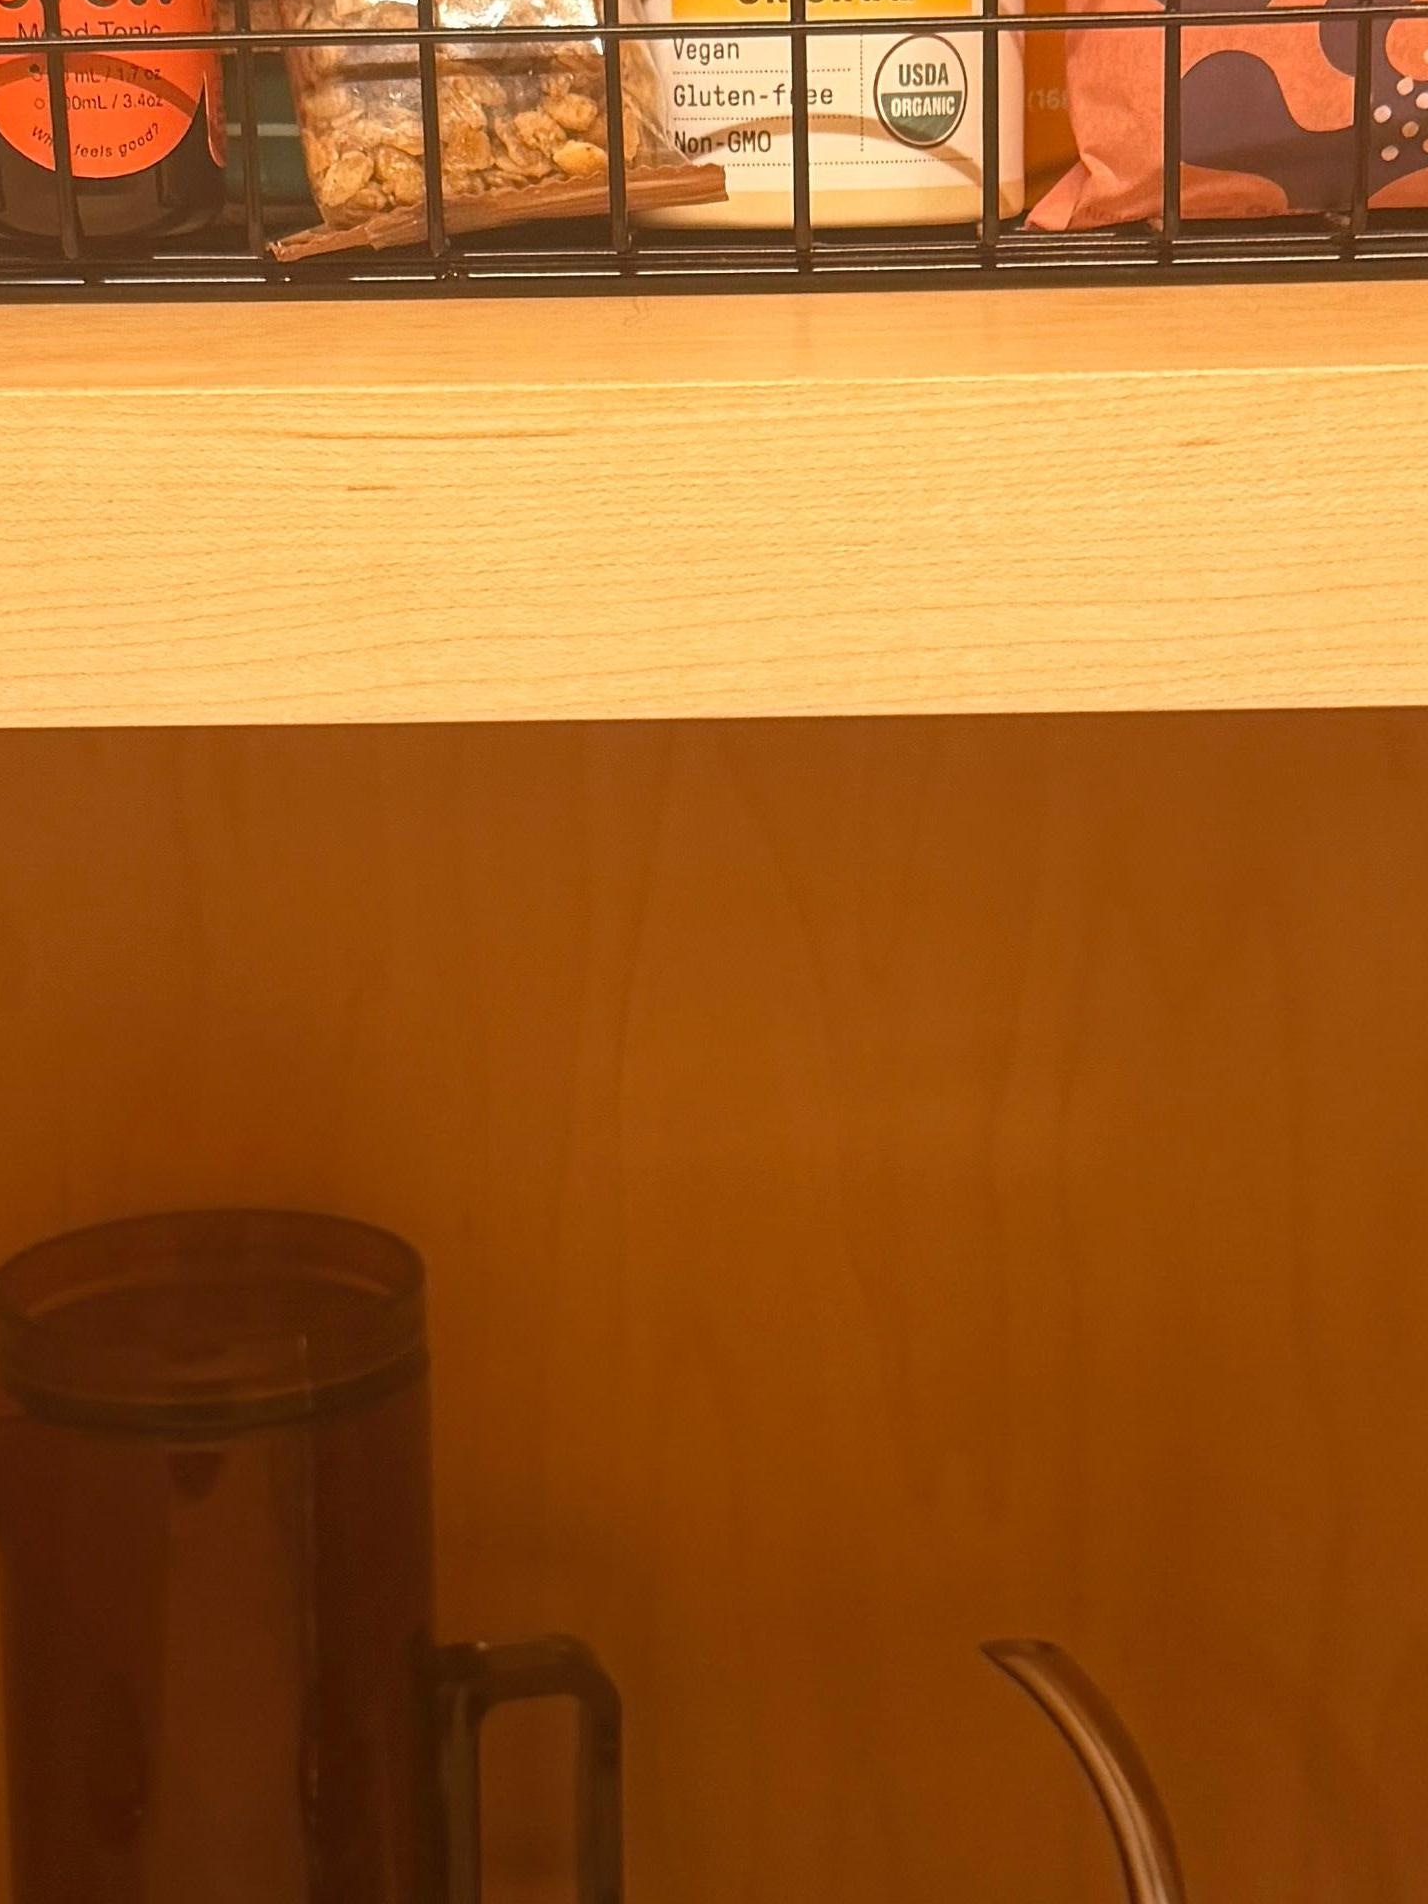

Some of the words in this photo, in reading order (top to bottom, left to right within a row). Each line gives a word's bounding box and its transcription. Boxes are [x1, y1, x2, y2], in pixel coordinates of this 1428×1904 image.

[98, 19, 163, 37] Tonic
[673, 38, 740, 66] Vegan
[73, 69, 101, 84] mL
[144, 69, 164, 81] oz
[898, 62, 950, 86] USDA
[673, 83, 834, 107] Gluten-fee
[890, 95, 956, 118] ORGANIC
[74, 143, 113, 158] feels
[119, 122, 161, 158] good?
[673, 130, 772, 155] Non-GMO
